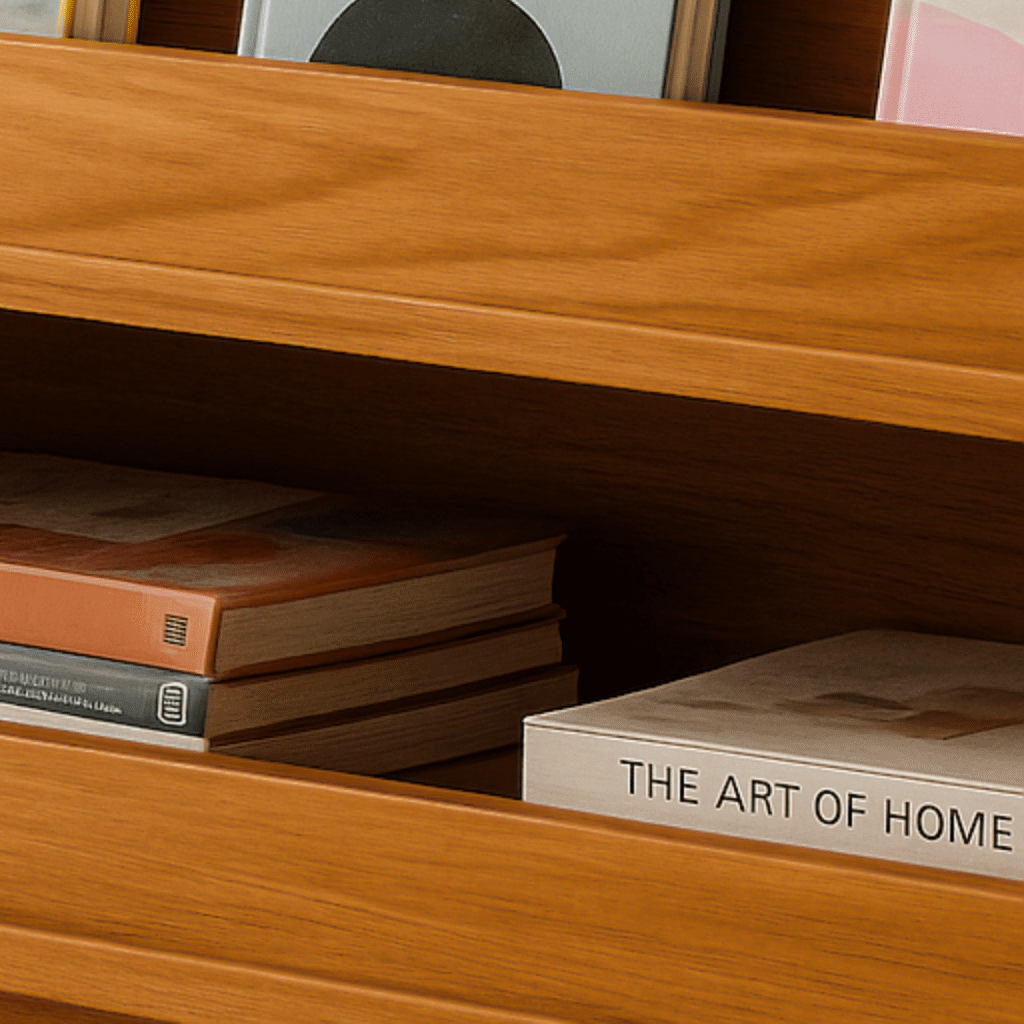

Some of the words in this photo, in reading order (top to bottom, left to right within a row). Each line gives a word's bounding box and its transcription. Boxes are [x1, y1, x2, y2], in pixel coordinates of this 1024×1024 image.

[619, 759, 700, 805] THE
[715, 775, 801, 819] ART
[813, 788, 867, 828] OF
[884, 798, 1014, 852] HOME
